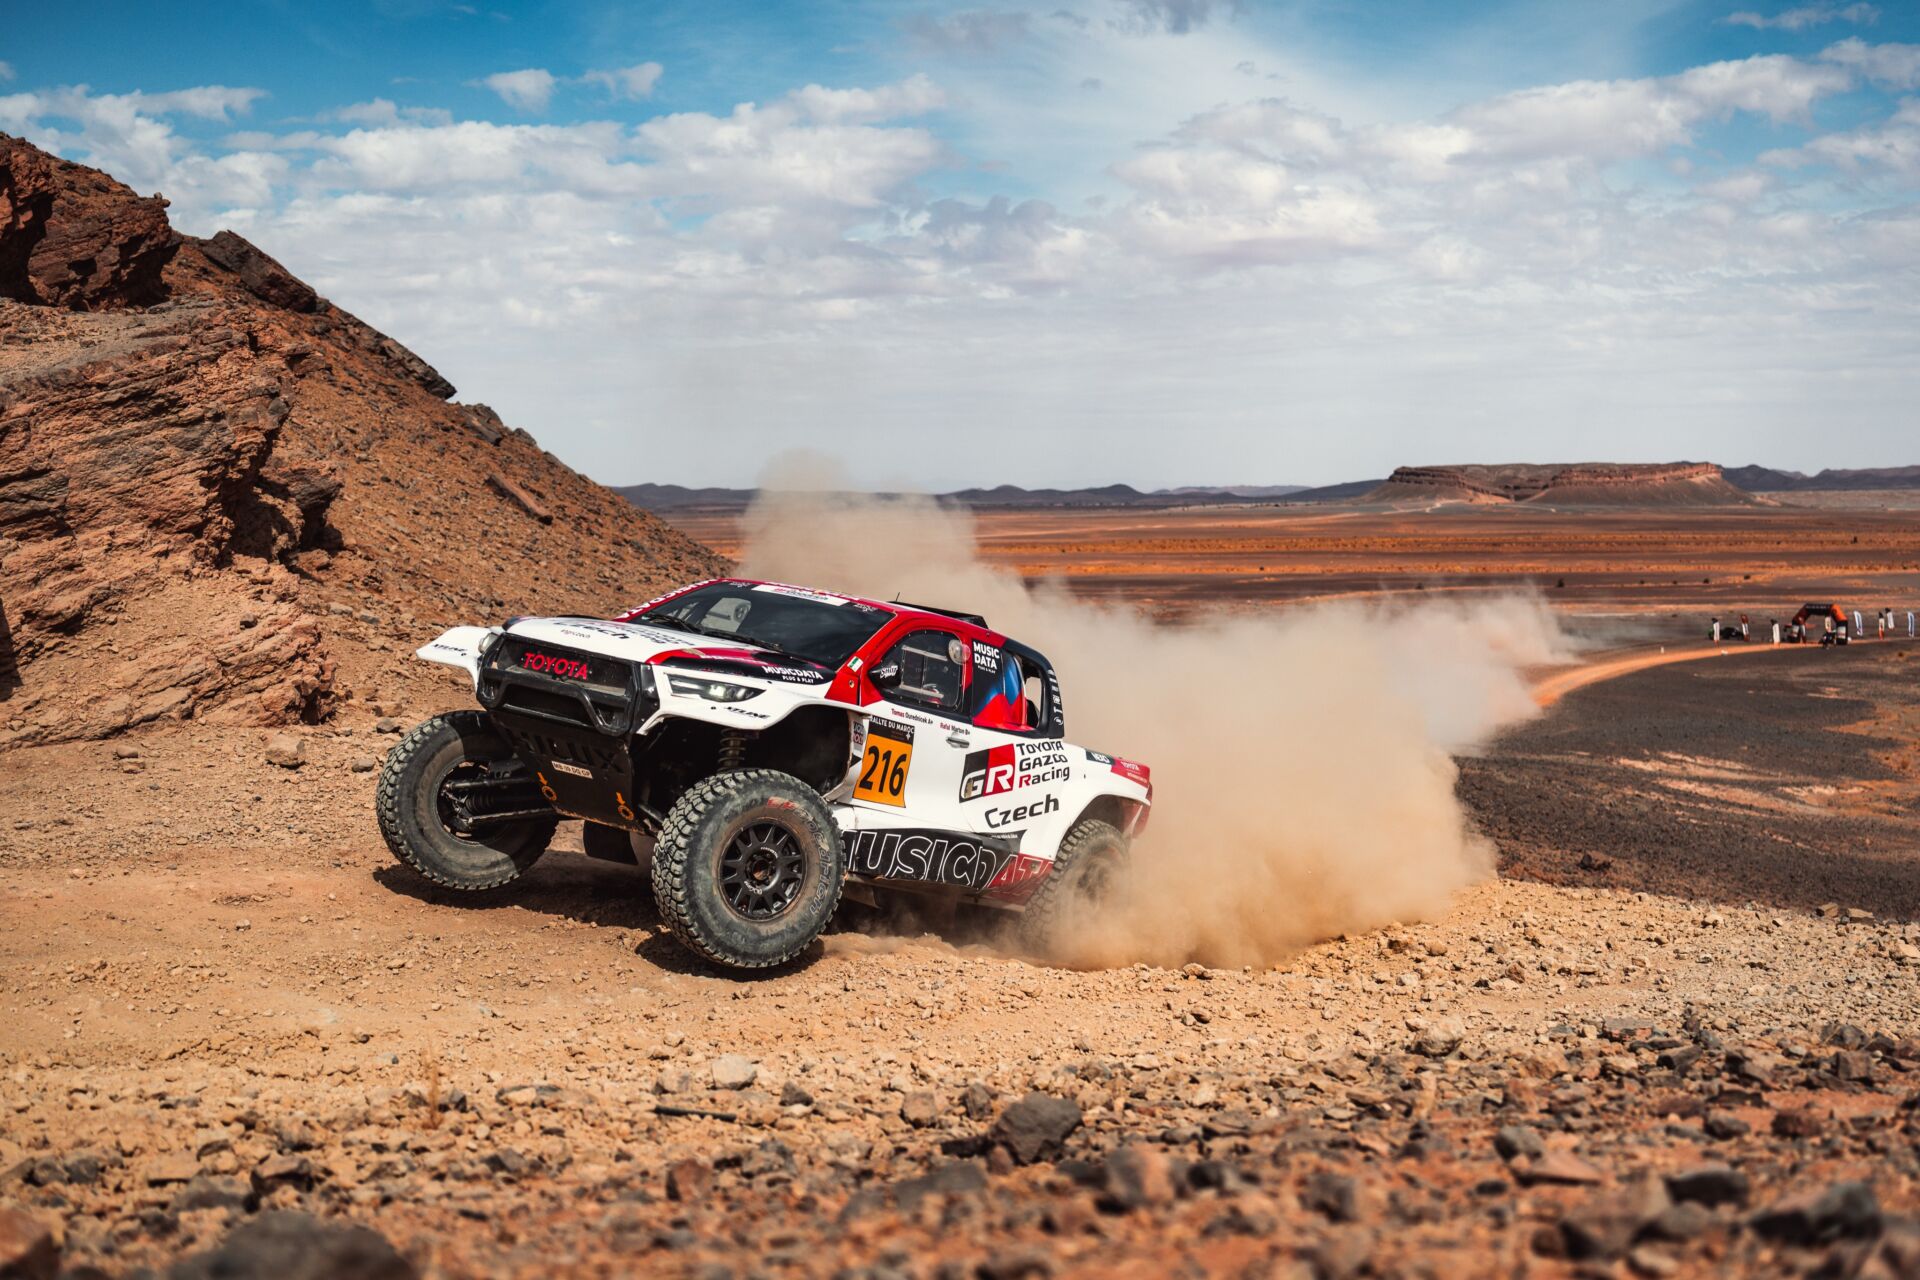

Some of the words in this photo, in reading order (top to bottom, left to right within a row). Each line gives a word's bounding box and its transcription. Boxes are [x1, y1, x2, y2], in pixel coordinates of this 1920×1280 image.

[973, 641, 1000, 659] MUSIC
[523, 652, 588, 680] TOYOTA
[974, 652, 998, 670] DATA
[761, 665, 823, 680] MUSICDATA
[724, 706, 770, 719] XTLINE
[891, 708, 905, 718] Tomas
[888, 720, 896, 728] DU
[896, 722, 915, 734] MAROC
[1016, 740, 1064, 756] TOYOTA
[859, 746, 907, 797] 216
[1018, 766, 1070, 789] Racing
[960, 764, 1014, 799] GR
[984, 793, 1059, 829] Czech
